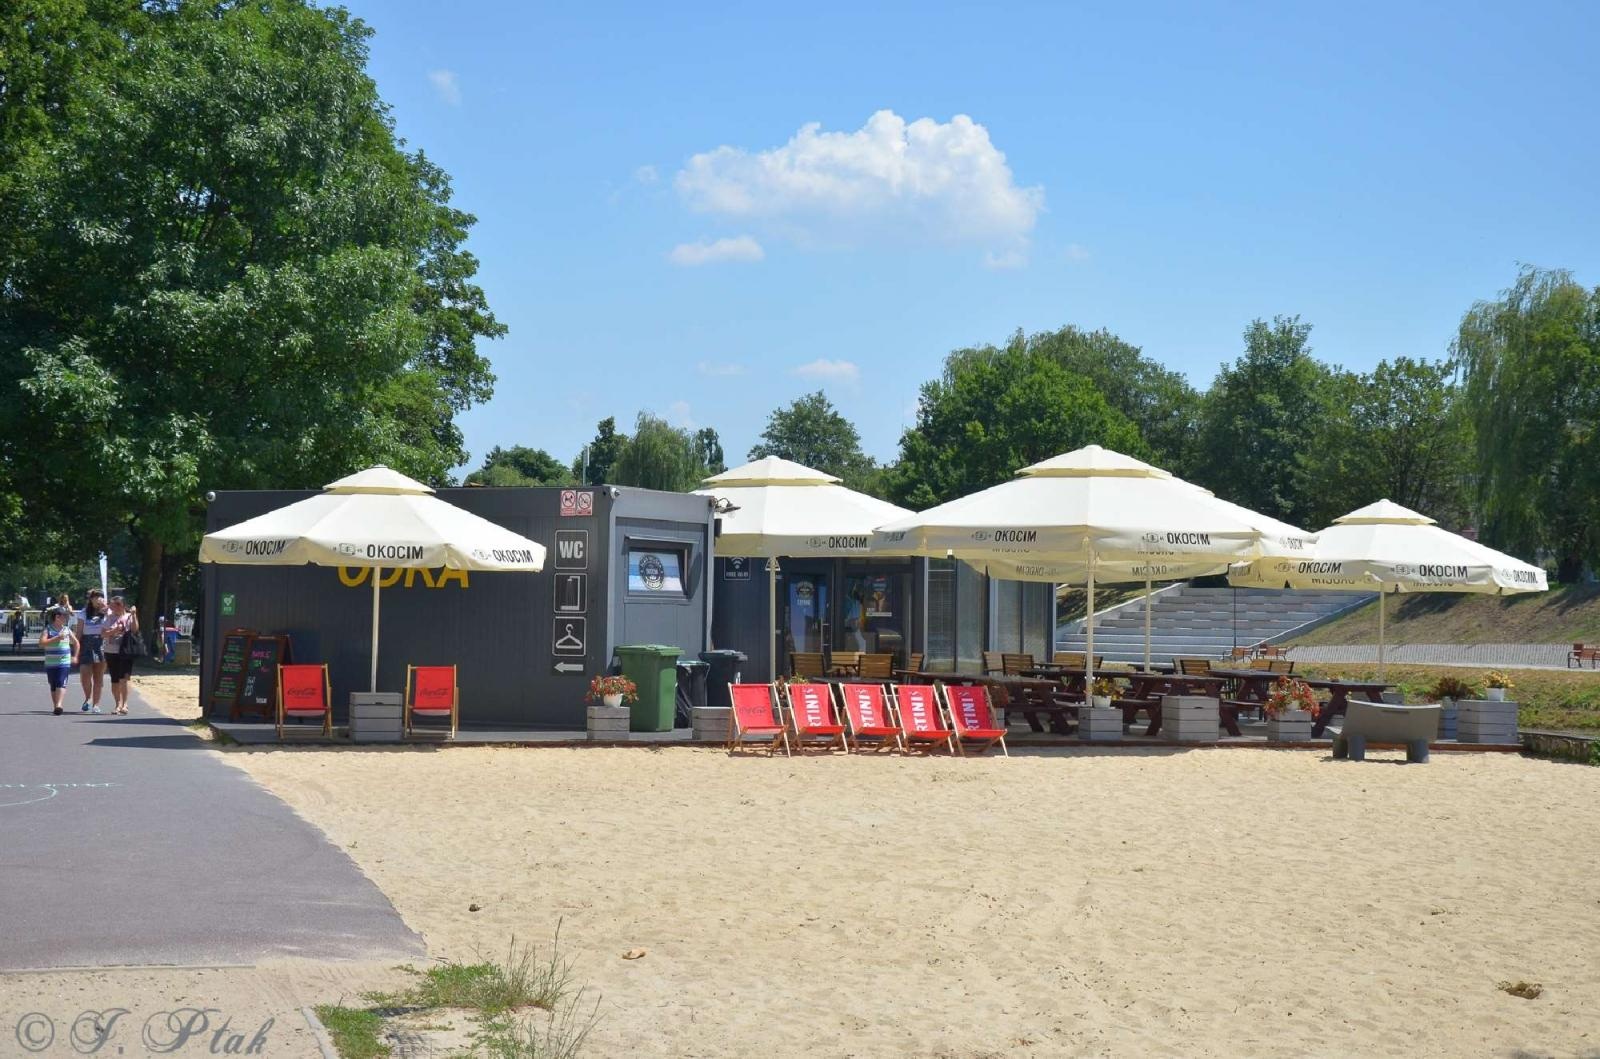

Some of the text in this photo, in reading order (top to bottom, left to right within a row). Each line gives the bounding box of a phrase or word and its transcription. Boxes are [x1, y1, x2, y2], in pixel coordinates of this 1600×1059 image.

[828, 536, 868, 549] OKOCIM
[994, 530, 1038, 543] OKOCIM
[1166, 532, 1211, 545] OKOCIM
[245, 540, 286, 556] OKOCIM
[366, 544, 424, 560] OKOCIM
[559, 540, 584, 559] WC
[492, 549, 534, 564] OKOCIM
[1298, 562, 1343, 574] OKOCIM
[1419, 564, 1469, 578] OKOCIM
[1513, 569, 1539, 584] OKOCIM
